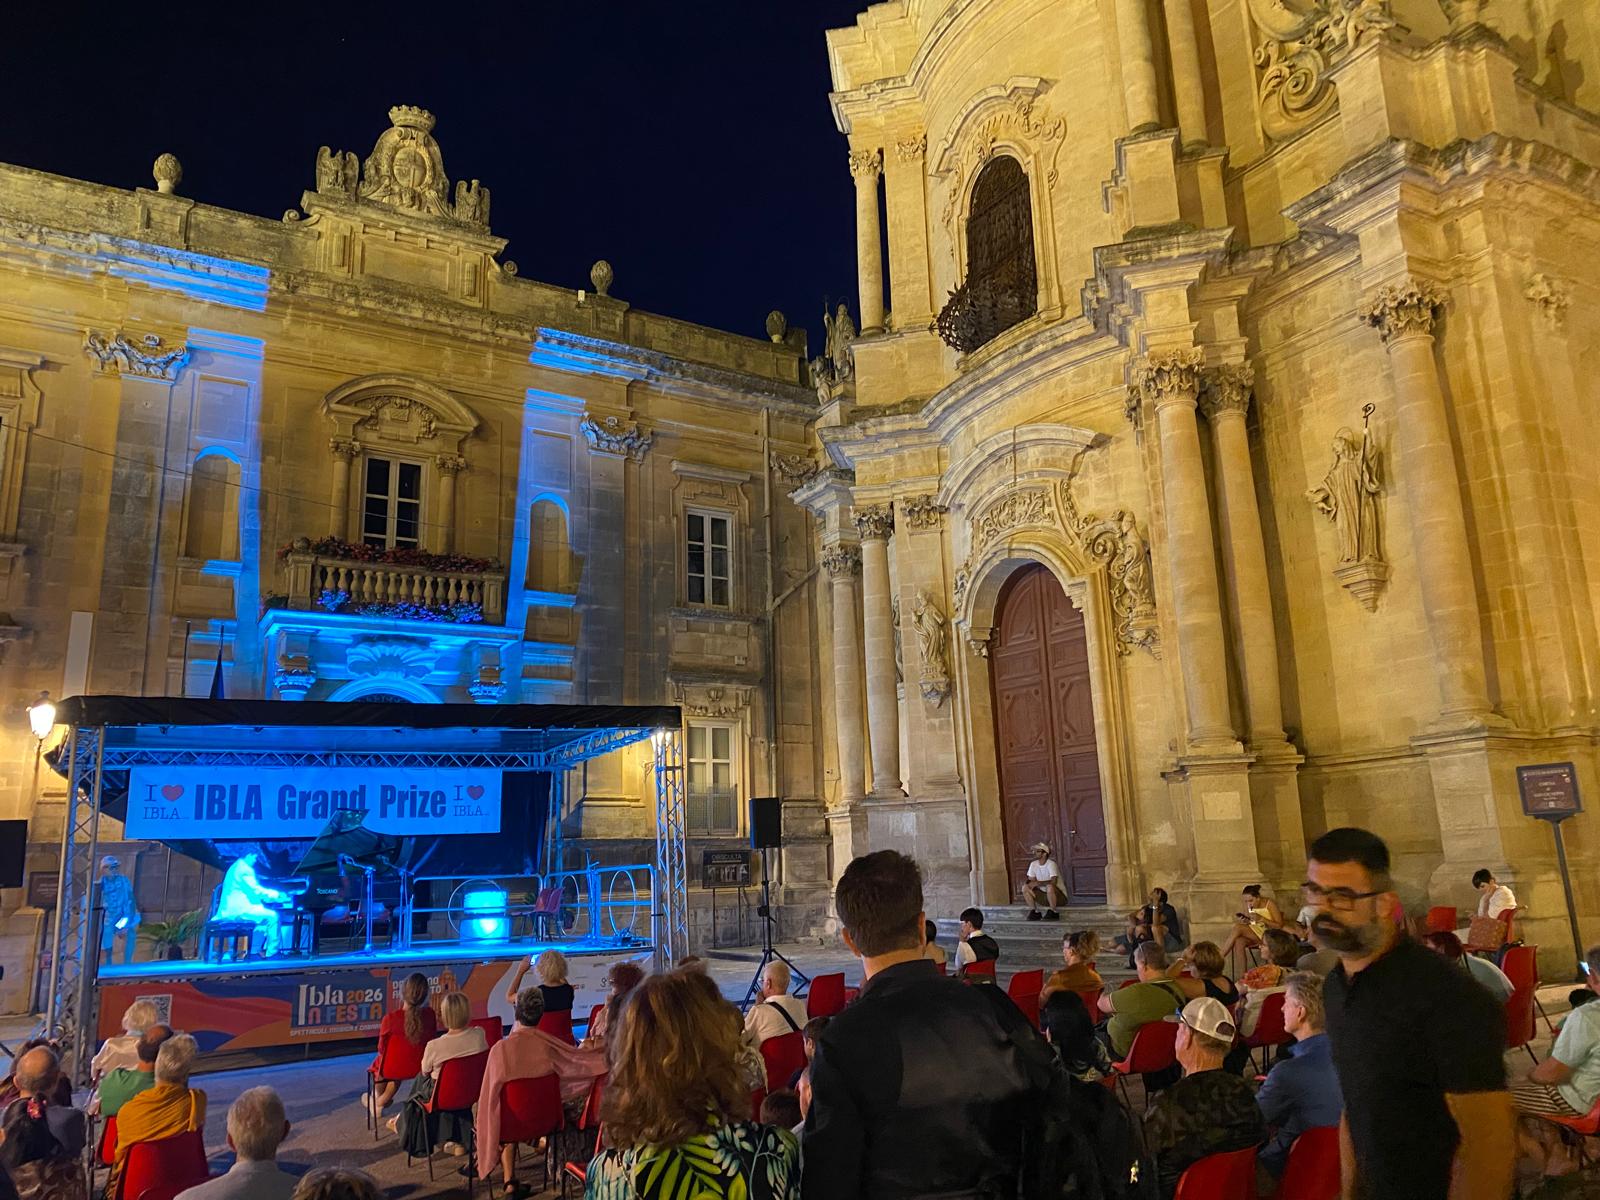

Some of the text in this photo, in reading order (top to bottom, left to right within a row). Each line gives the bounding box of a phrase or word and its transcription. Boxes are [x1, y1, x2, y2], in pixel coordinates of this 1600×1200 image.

[144, 784, 158, 801] I
[453, 785, 464, 800] I
[195, 784, 446, 820] IBLA Grand Prize
[347, 988, 383, 1003] 2026
[326, 1002, 383, 1023] FESTA
